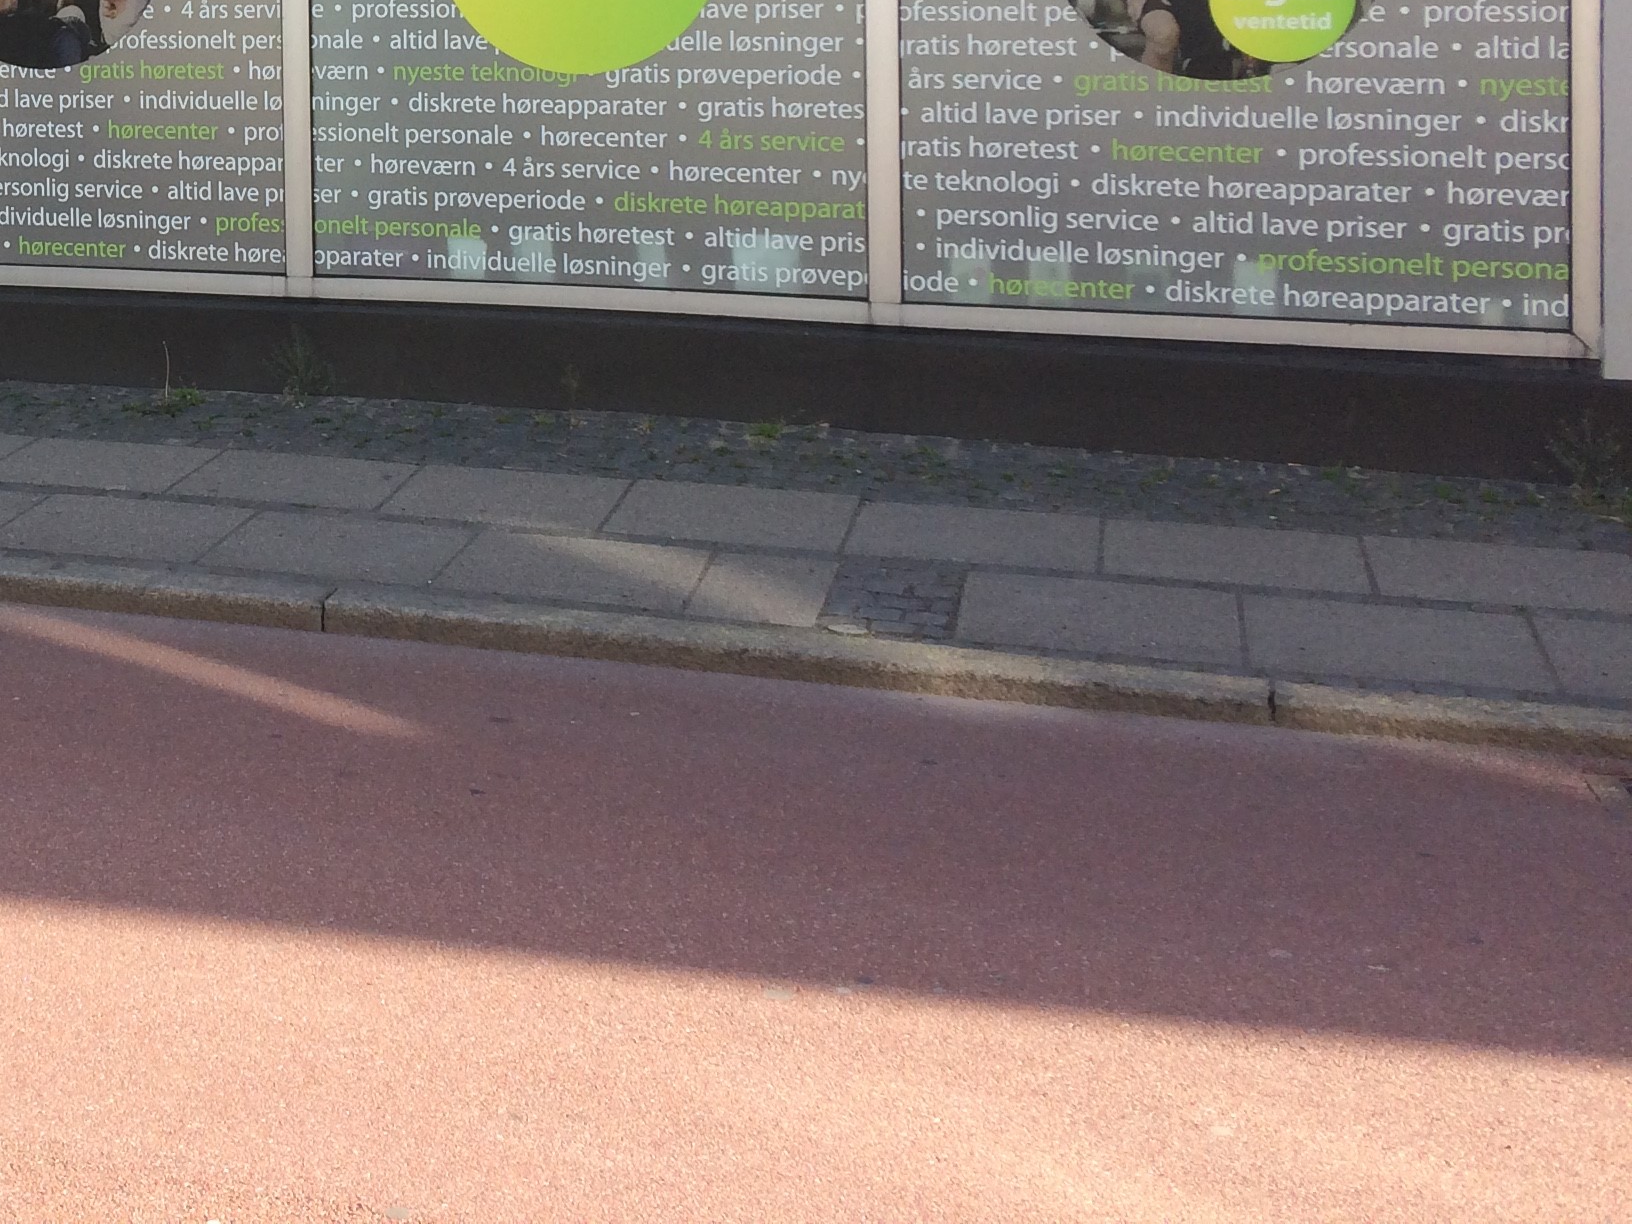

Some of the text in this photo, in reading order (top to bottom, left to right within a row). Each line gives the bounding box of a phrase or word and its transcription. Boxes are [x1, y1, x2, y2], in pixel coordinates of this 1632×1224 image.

[181, 0, 228, 19] 4 års
[1233, 12, 1334, 31] ventetid
[389, 29, 489, 51] altid lave
[729, 31, 844, 57] løsninger
[968, 34, 1077, 57] høretest
[1475, 36, 1540, 60] altid
[80, 62, 134, 83] gratis
[140, 60, 224, 80] høretest
[393, 66, 464, 85] nyeste
[605, 64, 670, 89] gratis
[677, 65, 842, 90] prøveperiode
[908, 67, 944, 89] års
[952, 69, 1042, 90] service
[1073, 72, 1149, 97] gratis
[1306, 71, 1445, 95] høreværn
[15, 89, 53, 108] lave
[59, 90, 114, 113] priser
[140, 91, 258, 111] individuelle
[409, 92, 864, 122] diskrete høreapparater gratis høretes
[3, 118, 83, 138] høretest
[108, 120, 218, 140] hørecenter
[921, 102, 1462, 137] altid lave priser individuelle løsninger
[405, 125, 845, 153] personale hørecenter 4 års service
[94, 149, 172, 170] diskrete
[968, 136, 1486, 170] høretest hørecenter professionelt
[371, 153, 802, 184] høreværn 4 års service hørecenter
[75, 180, 143, 199] service
[168, 181, 212, 201] altid
[219, 181, 259, 202] lave
[935, 169, 1060, 199] teknologi
[1092, 173, 1200, 197] diskrete
[1208, 176, 1412, 206] høreapparater
[368, 186, 865, 222] gratis prøveperiode diskrete høreapparat
[98, 209, 191, 234] løsninger
[375, 218, 814, 250] personale gratis høretest altid lave
[936, 206, 1058, 233] personlig
[1066, 209, 1158, 232] service
[1192, 210, 1253, 234] altid
[1262, 212, 1318, 236] lave
[1327, 217, 1407, 242] priser
[1443, 220, 1525, 247] gratis
[19, 236, 126, 259] hørecenter
[148, 239, 229, 261] diskrete
[936, 237, 1568, 282] individuelle løsninger professionelt persona
[427, 249, 768, 284] individuelle løsninger gratis
[989, 273, 1490, 316] hørecenter diskrete høreapparater
